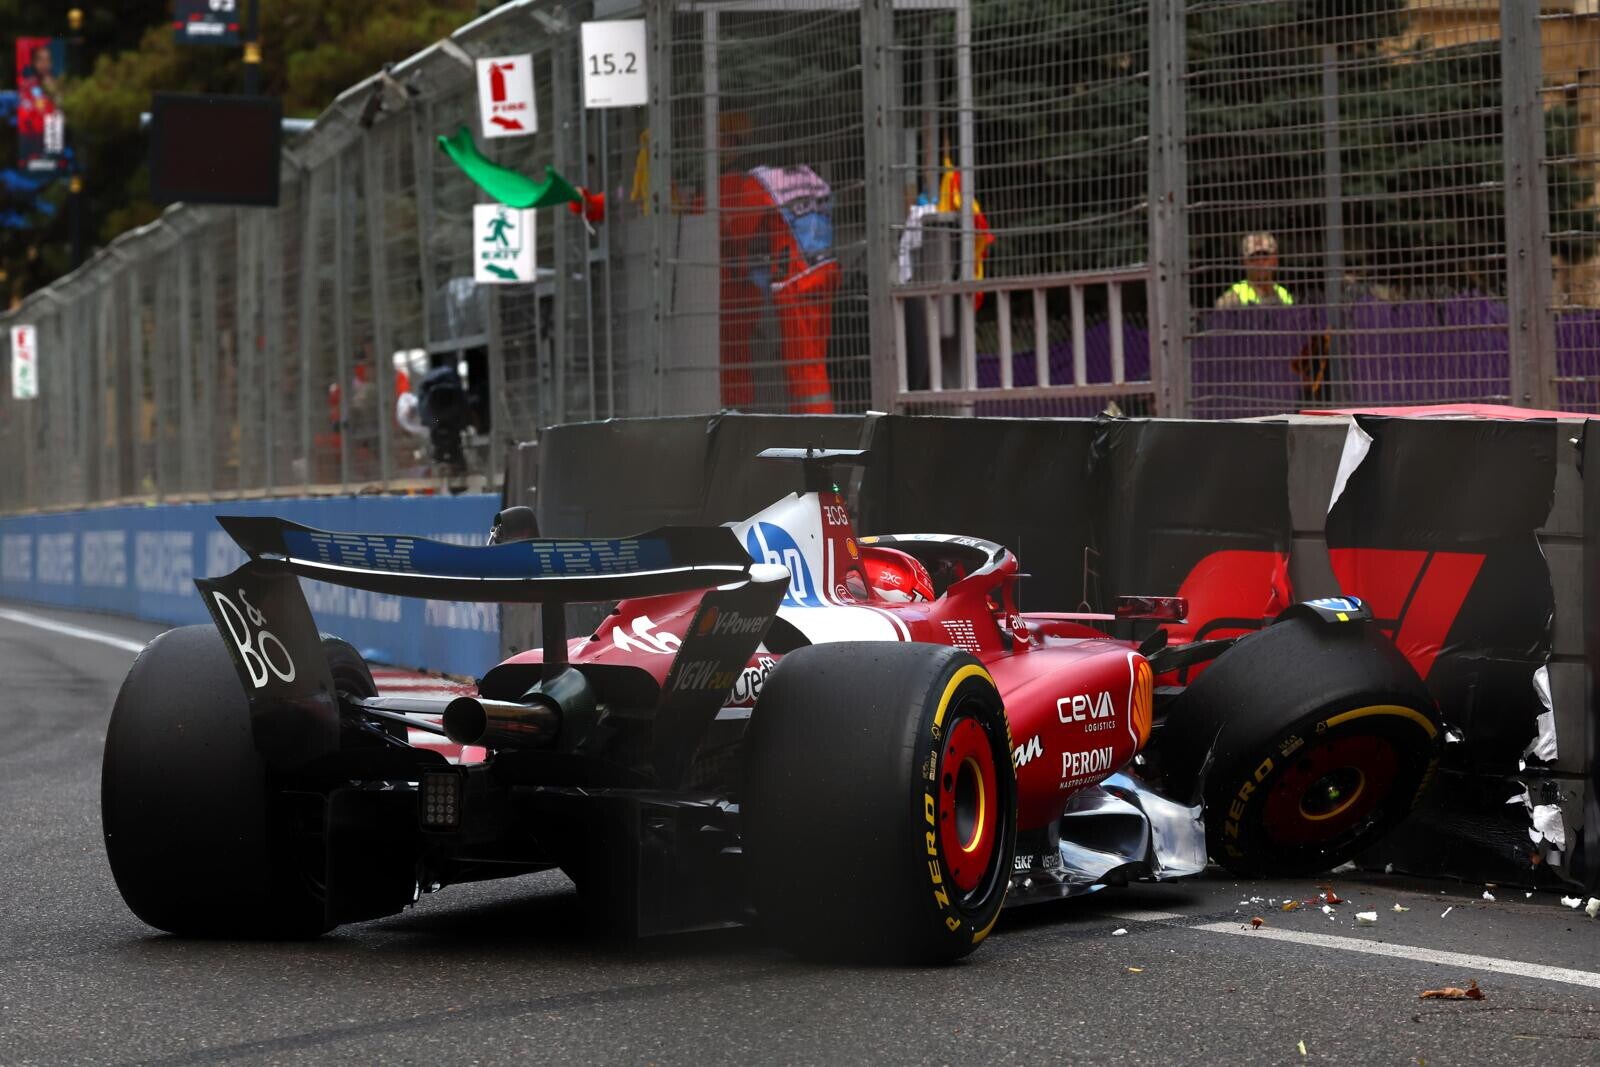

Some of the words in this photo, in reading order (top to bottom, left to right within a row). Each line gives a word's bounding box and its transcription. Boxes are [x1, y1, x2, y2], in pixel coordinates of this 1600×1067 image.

[589, 52, 637, 76] 15.2
[481, 250, 520, 260] EXIT
[823, 505, 849, 526] ZCG
[310, 532, 419, 573] IBM
[532, 540, 647, 577] IBM
[612, 615, 682, 655] 16
[710, 610, 770, 636] V-Power
[940, 618, 982, 652] IBM
[1084, 720, 1117, 733] LOGISTICS
[1061, 746, 1114, 779] PERONI
[1059, 778, 1083, 790] NASTRO
[1224, 757, 1275, 839] ZERO
[924, 793, 951, 910] ZERO
[1014, 855, 1034, 870] SKF
[945, 916, 961, 932] P
